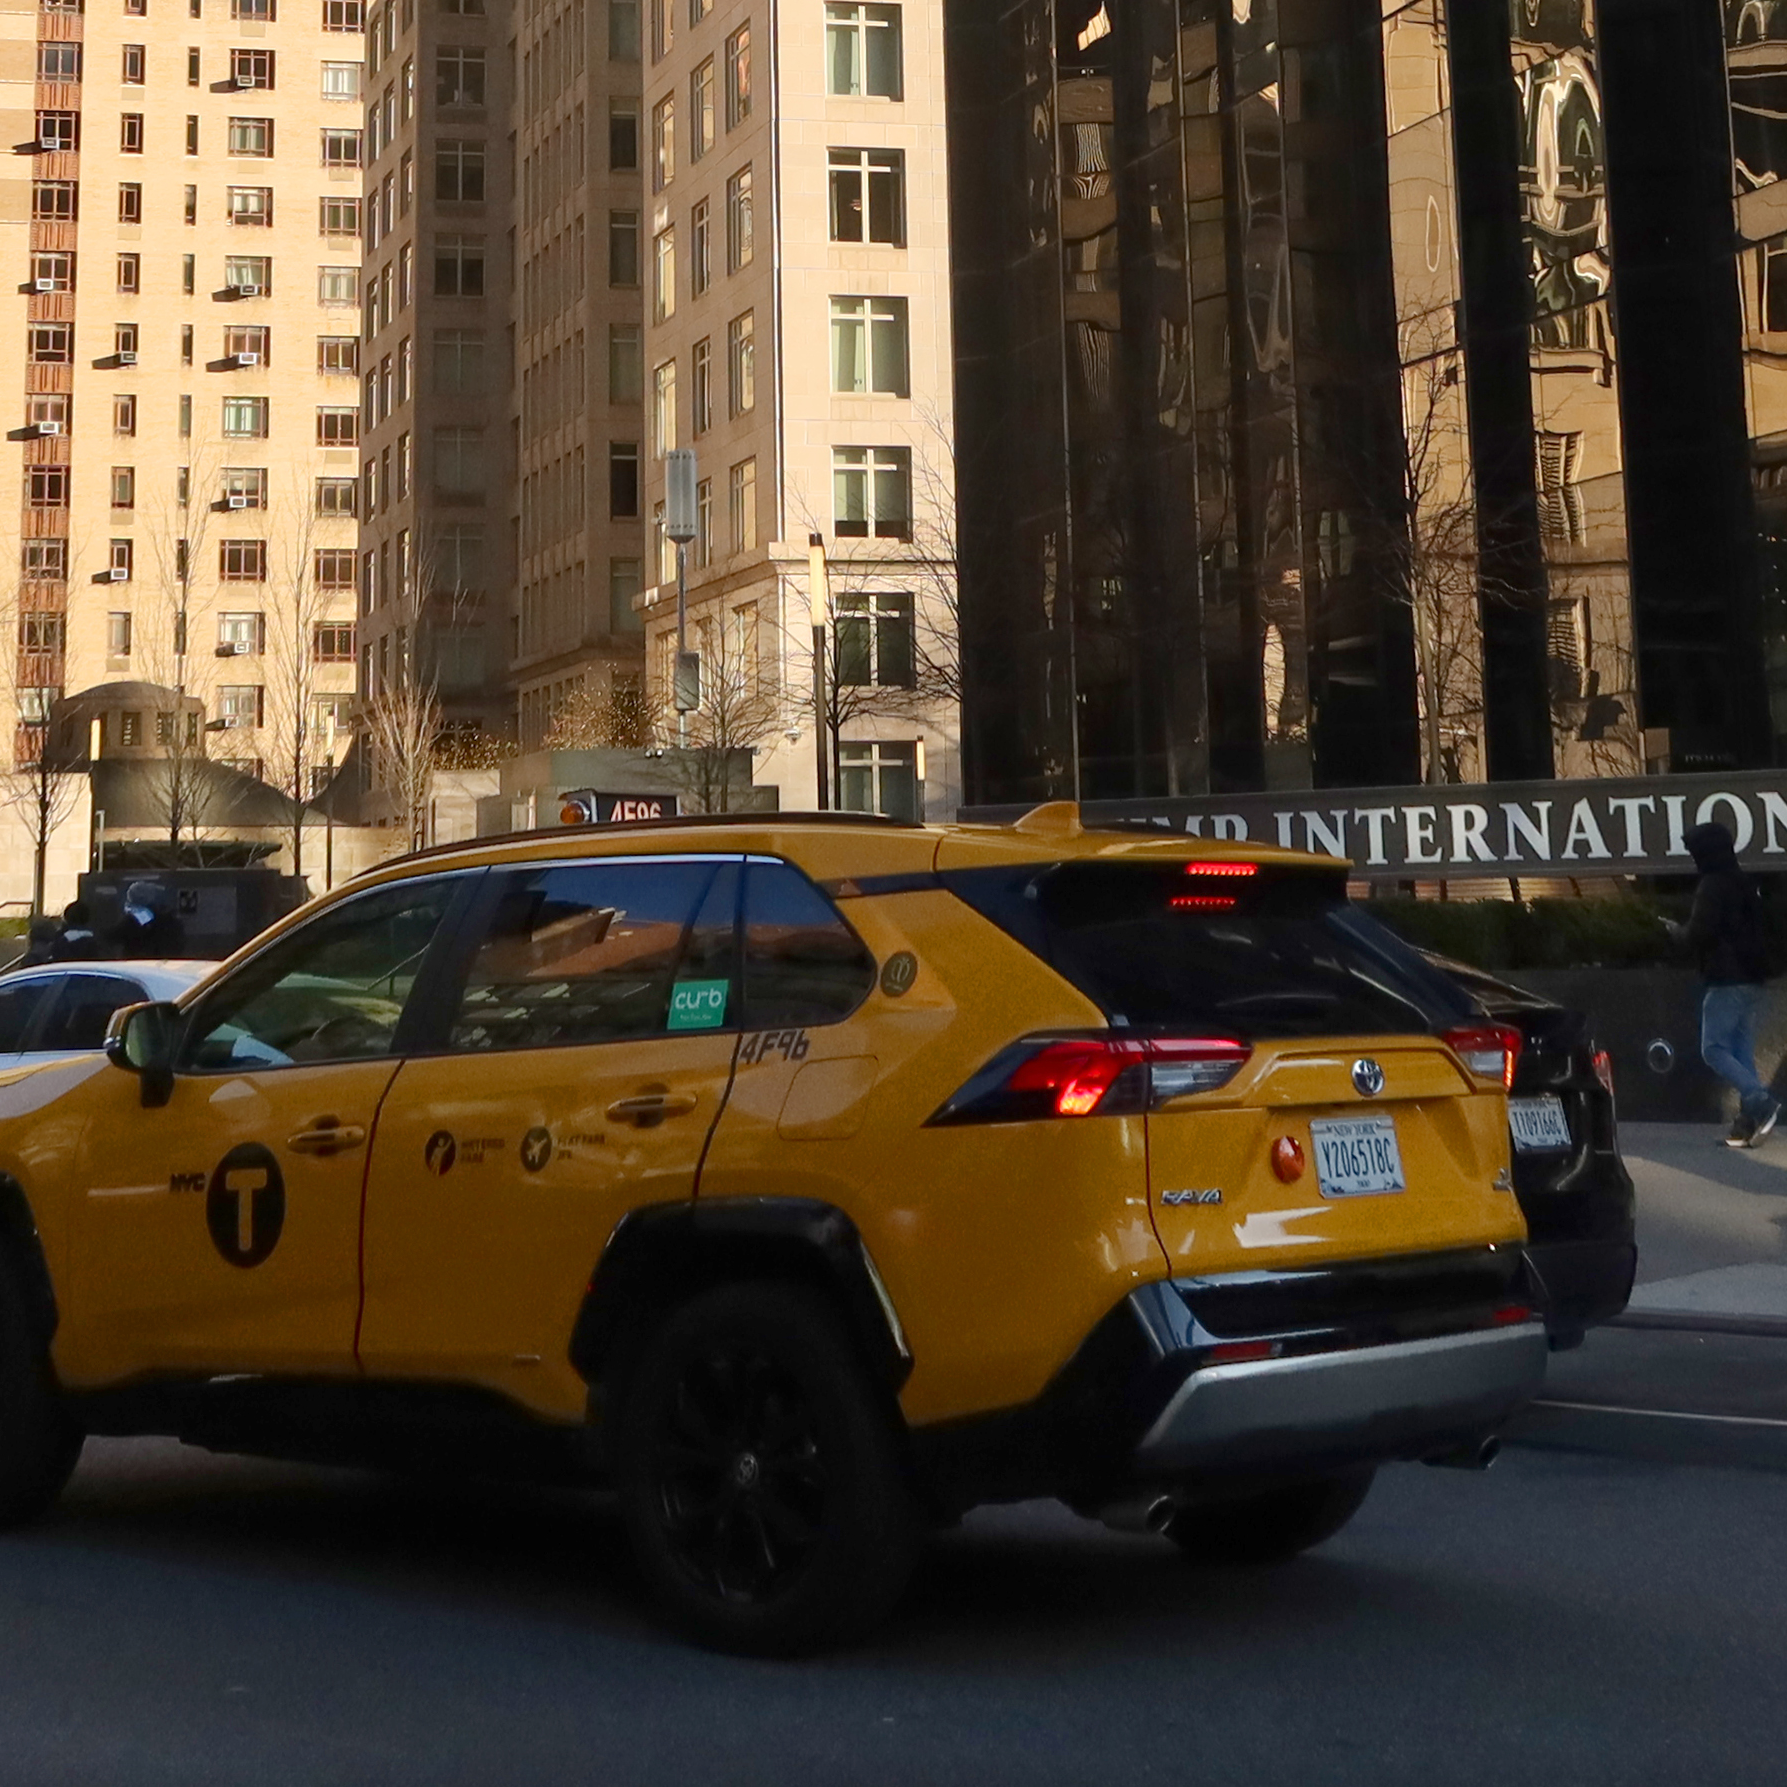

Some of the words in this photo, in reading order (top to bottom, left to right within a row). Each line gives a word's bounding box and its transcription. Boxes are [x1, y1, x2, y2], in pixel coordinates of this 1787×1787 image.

[675, 988, 722, 1009] curb
[740, 1029, 810, 1064] 4F96
[1321, 1137, 1395, 1179] Y206518C
